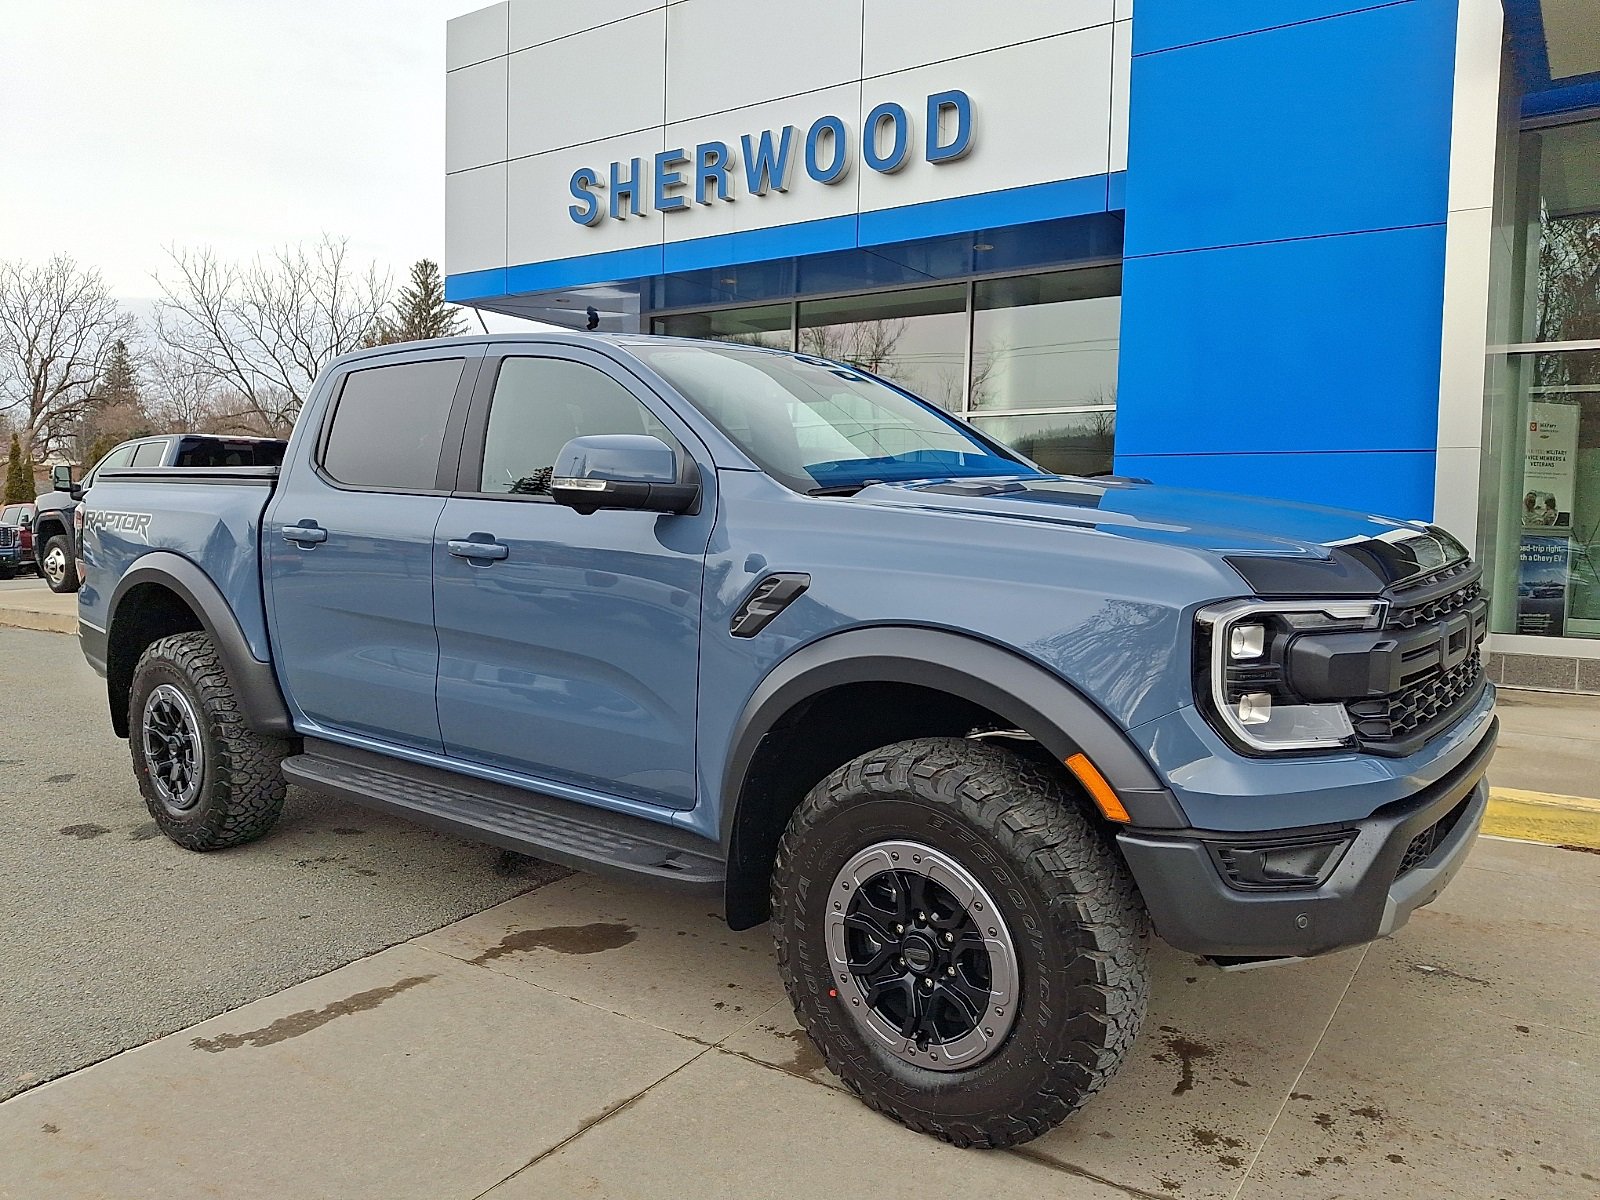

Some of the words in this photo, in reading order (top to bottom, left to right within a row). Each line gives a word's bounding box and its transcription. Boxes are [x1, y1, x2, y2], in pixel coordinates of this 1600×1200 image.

[568, 88, 979, 227] SHERWOOD
[84, 510, 152, 545] RAPTOR
[1520, 544, 1545, 553] oad-trip
[1546, 545, 1561, 553] right
[1533, 553, 1553, 563] Chevy
[1390, 599, 1489, 690] FOR
